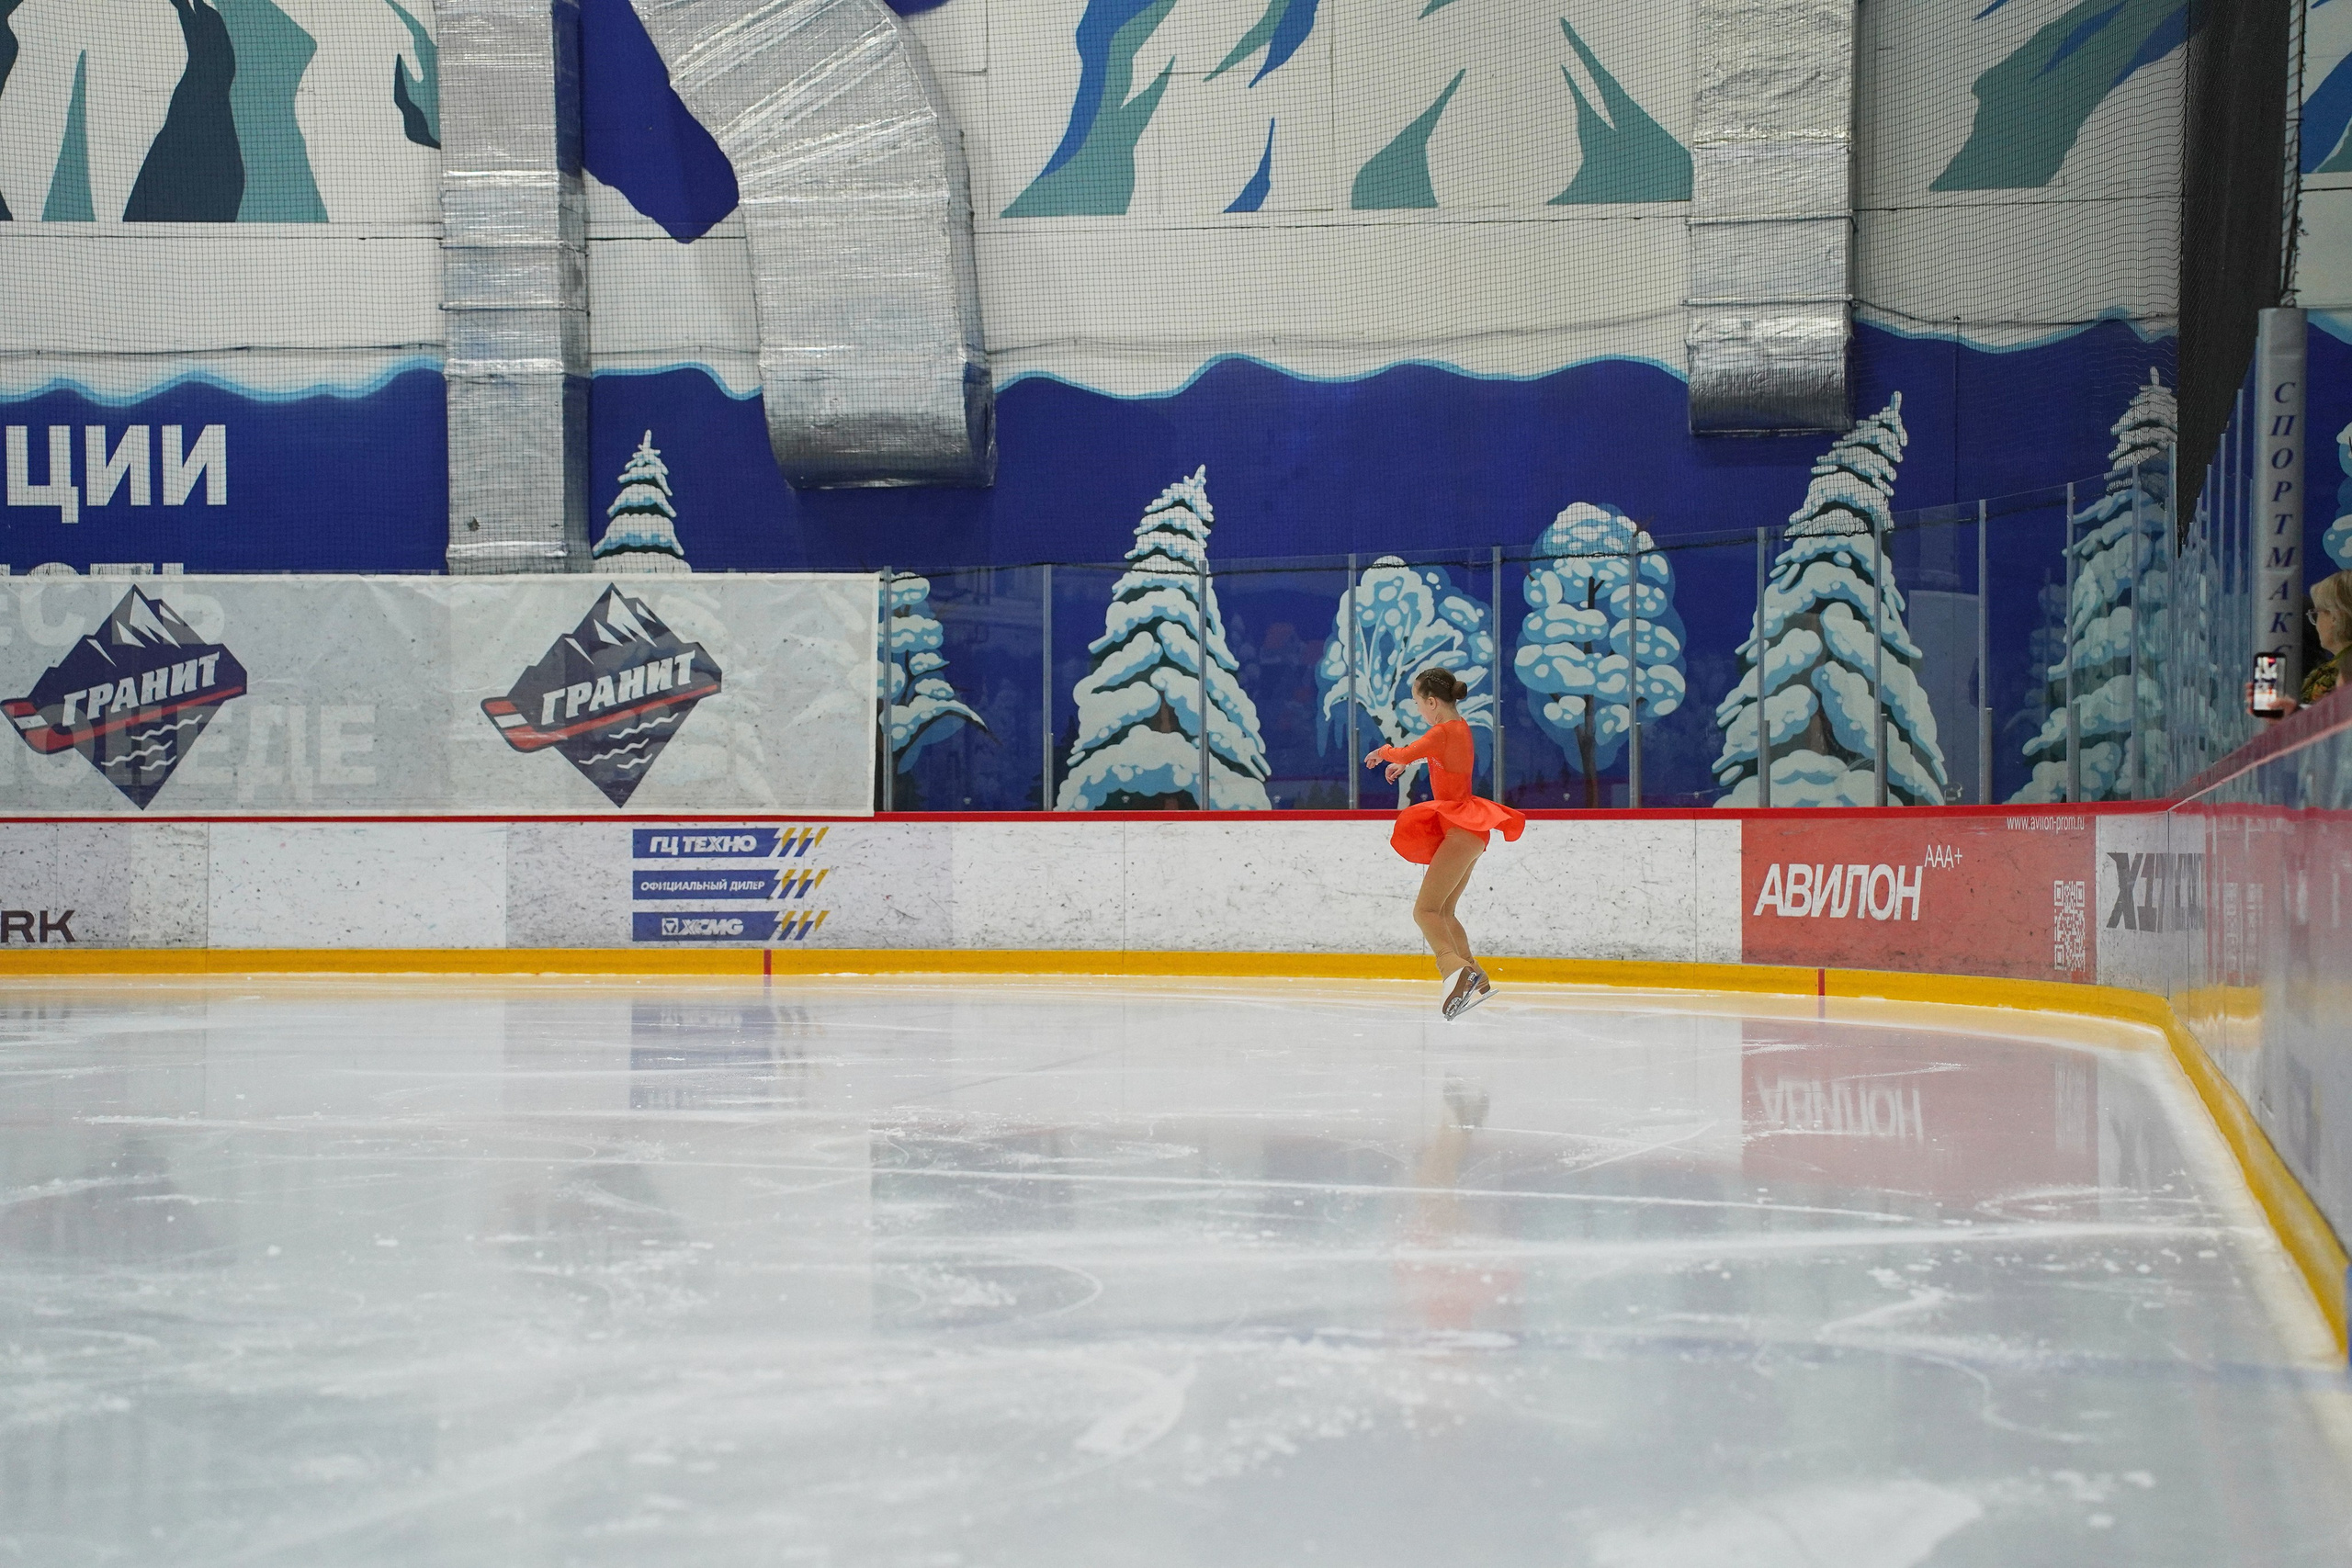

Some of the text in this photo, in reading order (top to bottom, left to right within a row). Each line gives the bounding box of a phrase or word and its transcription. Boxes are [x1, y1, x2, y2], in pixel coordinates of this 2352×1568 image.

[6, 424, 227, 523] ЦИИ
[62, 651, 220, 727] ГРАНИТ
[540, 650, 696, 725] ГРАНИТ
[650, 835, 757, 855] ГЦ ТЕХНО
[640, 878, 765, 892] ОФИЦИАЛЬНЫЙ ДИЛЕР
[1753, 863, 1923, 921] АВИЛОН
[1, 909, 76, 942] RK
[678, 919, 744, 935] XCMG
